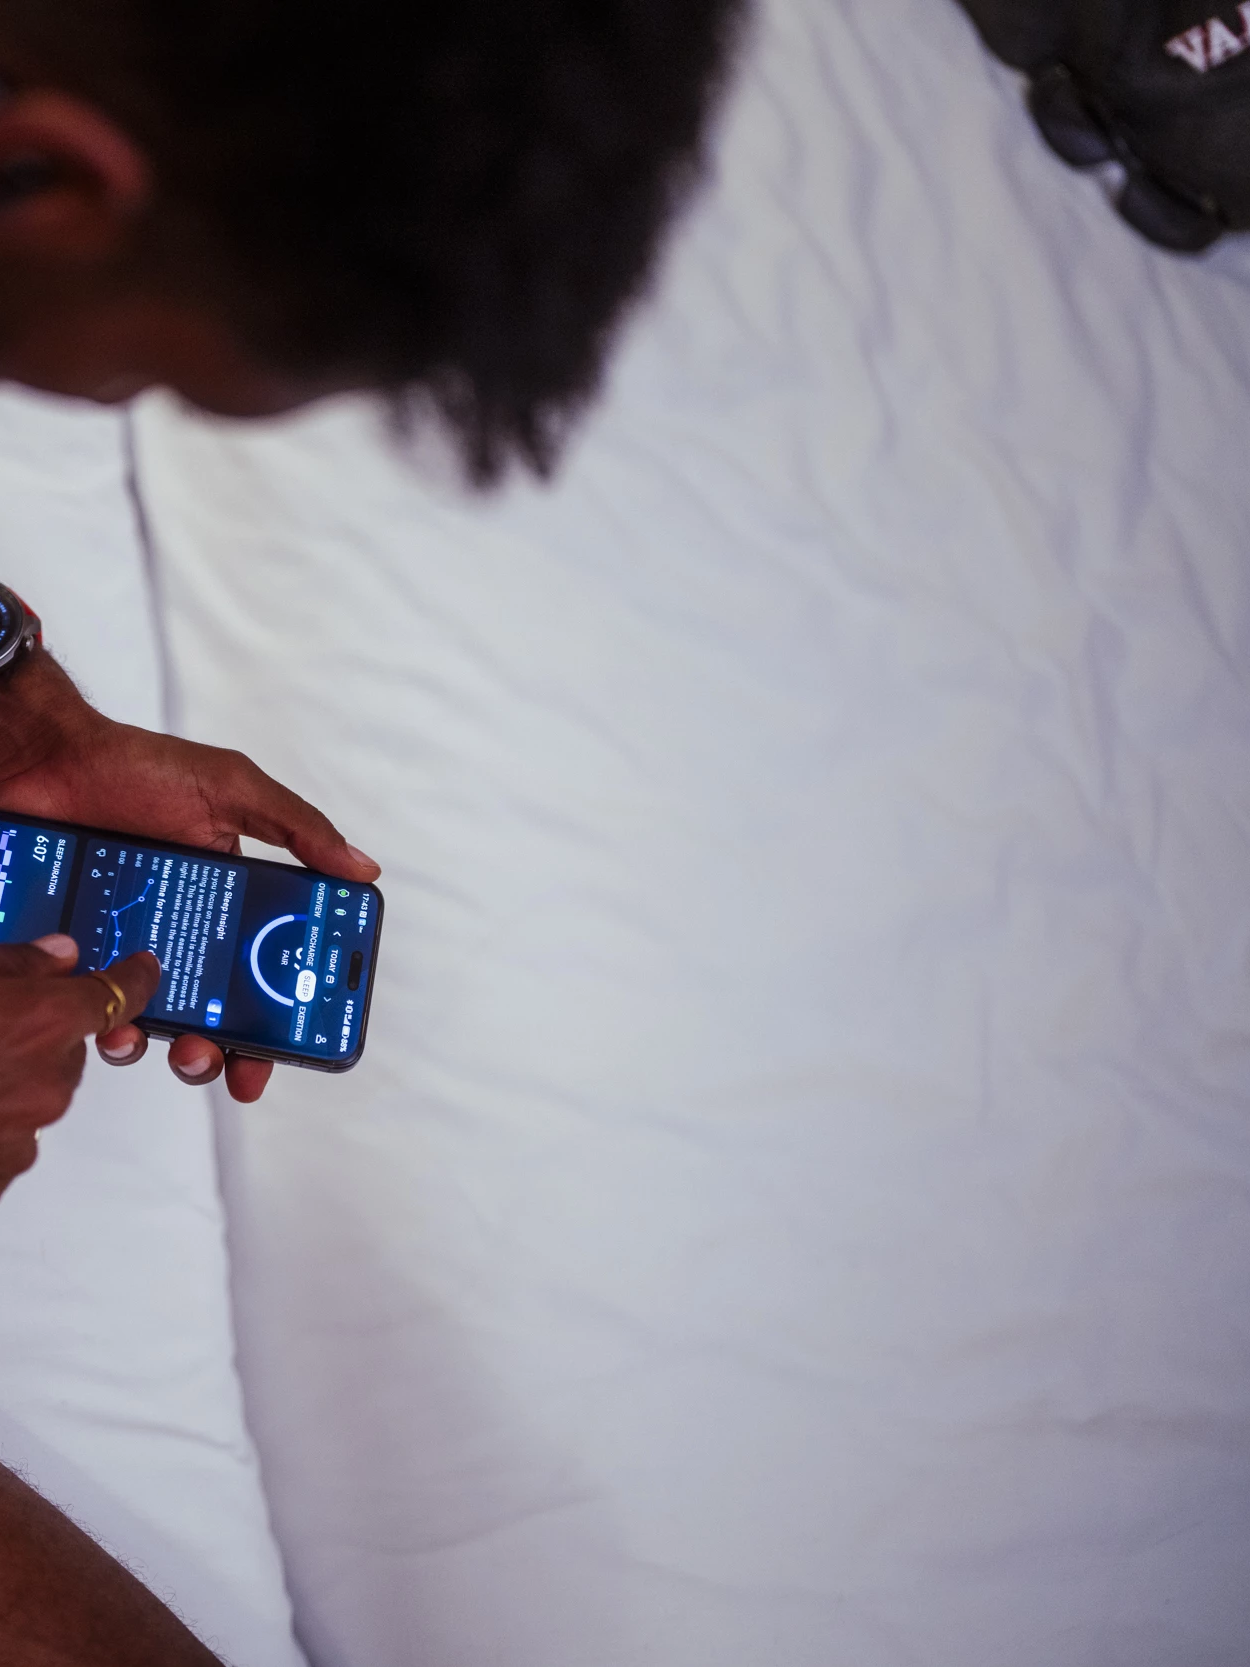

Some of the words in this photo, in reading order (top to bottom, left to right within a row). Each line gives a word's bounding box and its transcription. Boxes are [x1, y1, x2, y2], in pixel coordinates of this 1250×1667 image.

[32, 835, 50, 863] 6:07
[55, 839, 66, 860] SLEEP
[118, 850, 126, 865] 03:00
[162, 858, 173, 879] Wake
[178, 861, 189, 879] night
[190, 864, 200, 883] week.
[199, 866, 211, 888] having
[213, 868, 221, 877] As
[48, 861, 61, 896] DURATION
[177, 880, 186, 892] and
[210, 878, 218, 890] you
[224, 870, 236, 890] Daily
[158, 880, 169, 898] time
[187, 884, 196, 899] This
[156, 898, 166, 910] for
[174, 893, 183, 911] wake
[185, 899, 193, 912] will
[196, 894, 205, 912] wake
[208, 891, 217, 910] focus
[220, 891, 233, 912] Sleep
[313, 882, 326, 918] OVERVIEW
[360, 893, 370, 910] 17:43
[153, 910, 164, 924] the
[170, 911, 179, 920] up
[181, 912, 191, 931] make
[193, 913, 202, 928] time
[206, 911, 212, 920] on
[148, 924, 160, 942] past
[168, 929, 177, 940] the
[190, 928, 199, 943] that
[201, 920, 211, 935] your
[215, 913, 229, 940] Insight
[176, 937, 186, 959] easier
[198, 936, 209, 955] sleep
[305, 926, 319, 967] BIOCHARGE
[161, 941, 174, 971] morning!
[174, 959, 182, 967] to
[184, 951, 195, 974] similar
[281, 950, 290, 966] FAIR
[328, 949, 338, 972] TODAY
[172, 968, 181, 980] fall
[194, 955, 205, 979] health,
[166, 980, 179, 1003] asleep
[180, 975, 190, 998] across
[189, 979, 201, 1010] consider
[301, 975, 311, 997] SLEEP
[166, 1004, 173, 1012] at
[178, 999, 186, 1011] the
[293, 1005, 306, 1042] EXERTION
